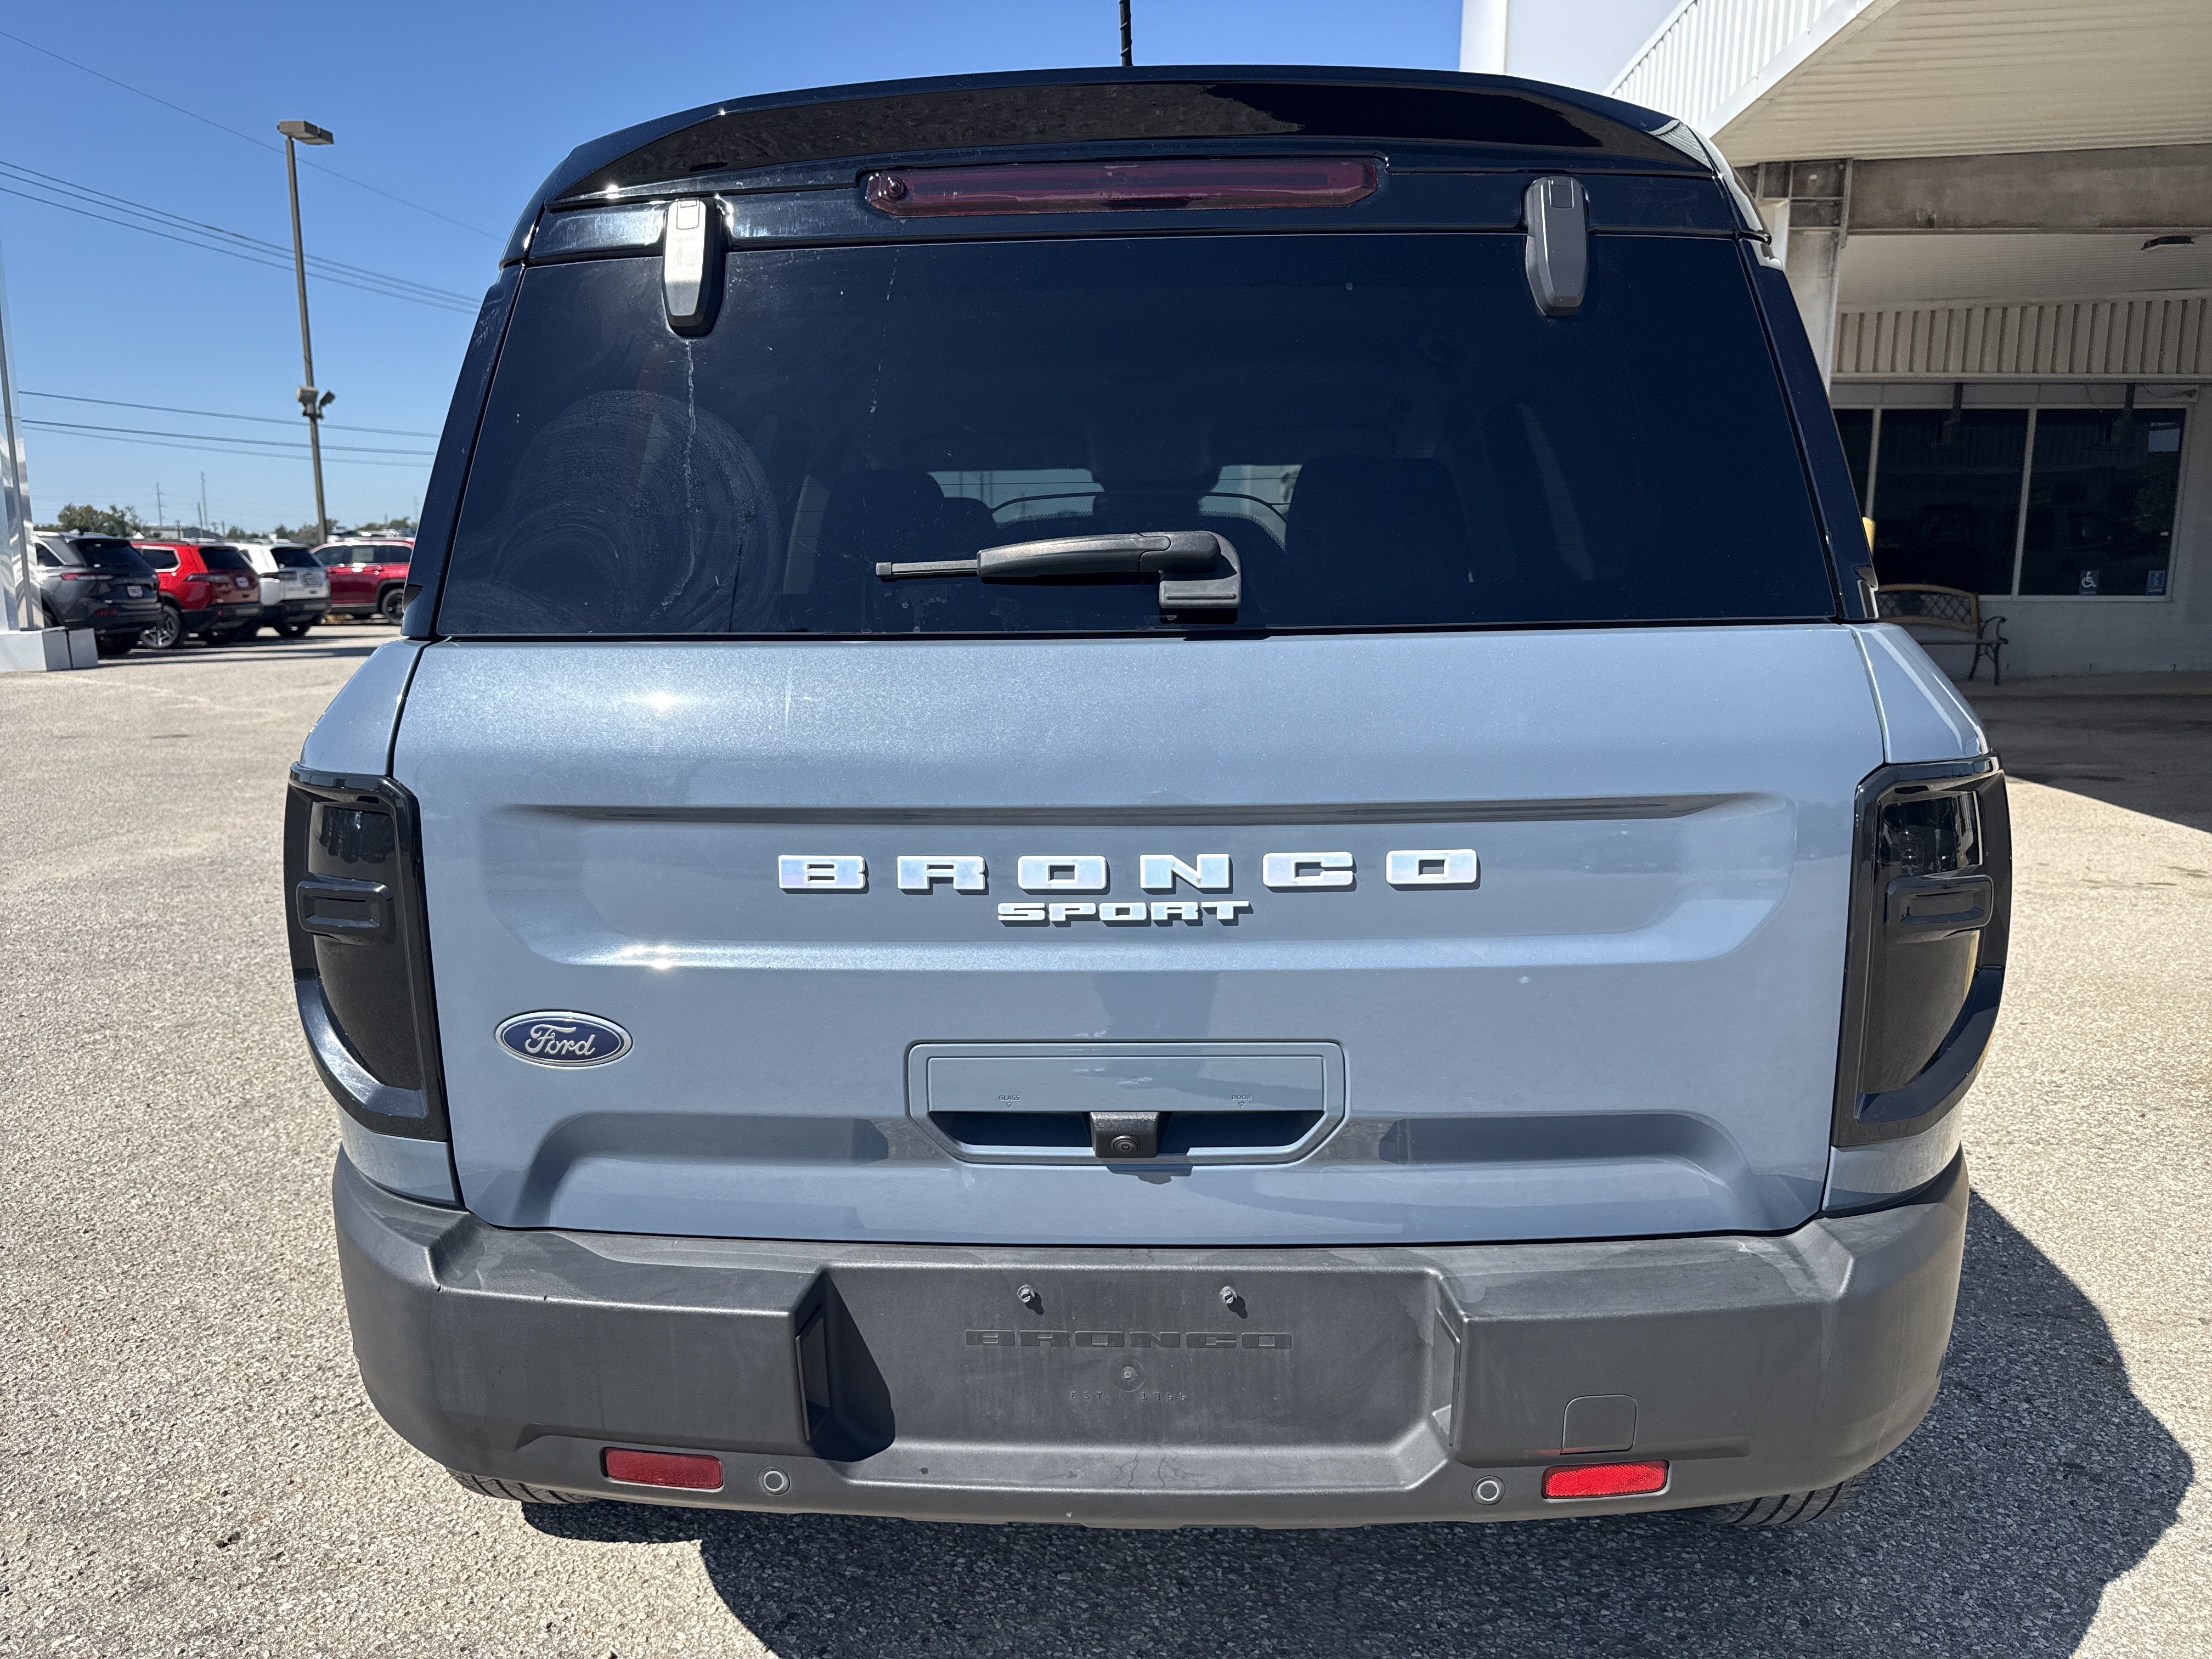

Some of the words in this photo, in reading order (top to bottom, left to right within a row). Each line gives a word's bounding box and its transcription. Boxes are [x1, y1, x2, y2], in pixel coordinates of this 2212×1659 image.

[778, 849, 1477, 890] BRONCO
[997, 901, 1250, 921] SPORT
[525, 1024, 596, 1056] Ford
[966, 1330, 1292, 1348] BRONCO
[1071, 1391, 1108, 1400] EST.
[1141, 1391, 1186, 1401] 1966
